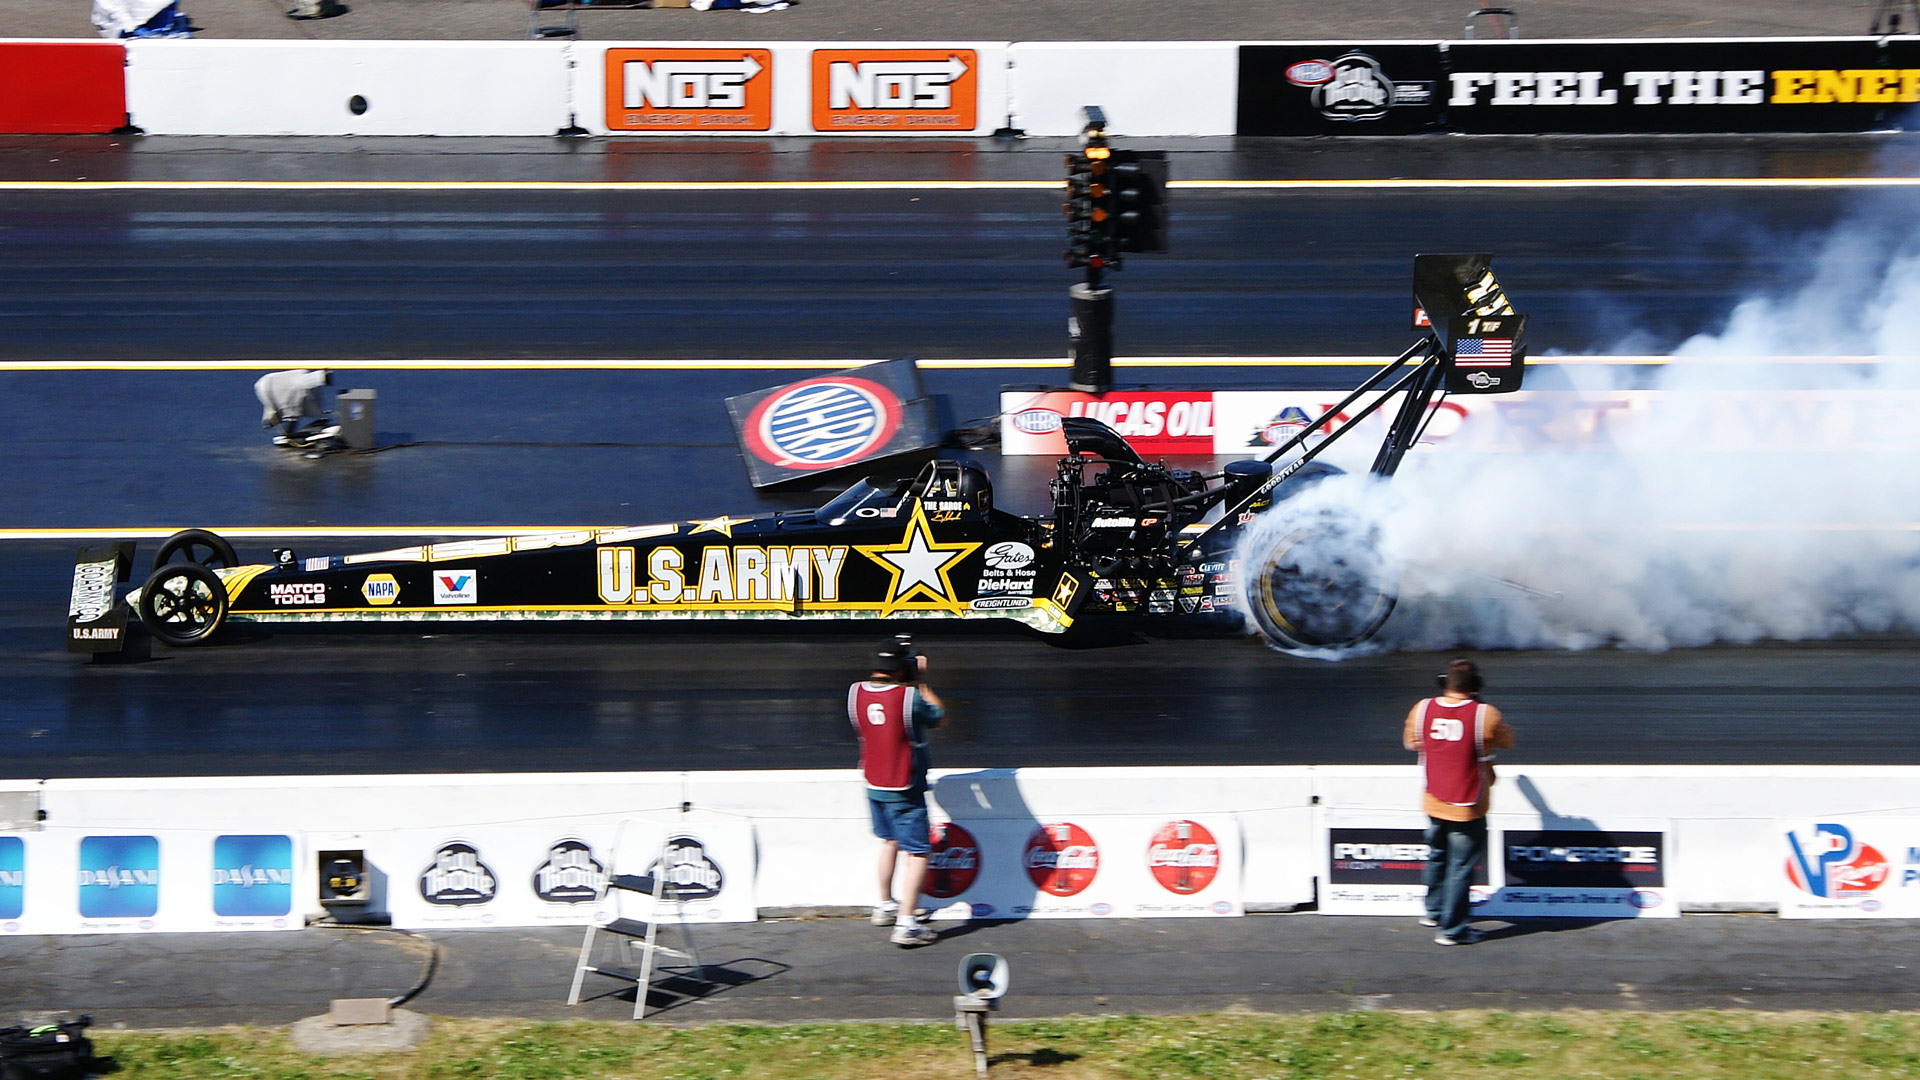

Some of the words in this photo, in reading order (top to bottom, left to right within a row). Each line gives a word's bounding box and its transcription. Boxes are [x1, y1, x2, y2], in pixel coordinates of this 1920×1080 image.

[624, 56, 761, 109] NOS
[829, 57, 966, 109] NOS
[1448, 71, 1618, 106] FEEL
[1624, 70, 1765, 105] THE
[772, 386, 878, 460] NHRA
[1167, 401, 1215, 436] OIL
[924, 501, 937, 511] THE
[597, 545, 849, 604] U.S.ARMY
[983, 569, 1005, 577] Belts
[1006, 569, 1013, 577] &
[1015, 569, 1036, 577] Hose
[77, 566, 105, 622] GOARMY.CO
[270, 583, 325, 594] MATCO
[368, 583, 394, 597] NAPA
[978, 579, 1033, 591] DieHard
[270, 594, 325, 605] TOOLS
[976, 599, 1028, 608] FREIGHTLINER
[73, 628, 119, 640] U.S.ARMY
[867, 703, 886, 725] 6
[1428, 718, 1464, 741] 50
[1334, 843, 1432, 861] POWER
